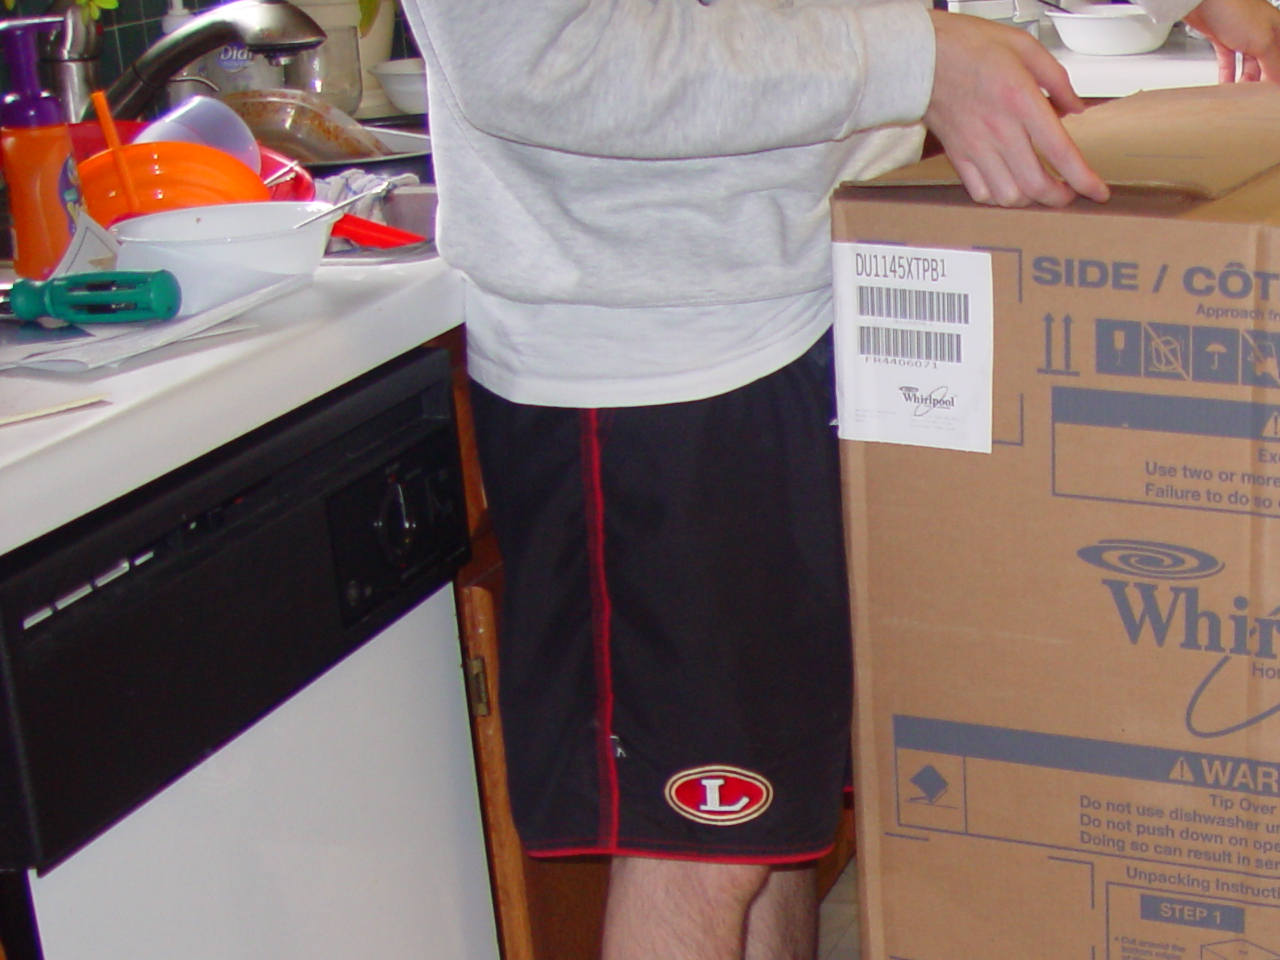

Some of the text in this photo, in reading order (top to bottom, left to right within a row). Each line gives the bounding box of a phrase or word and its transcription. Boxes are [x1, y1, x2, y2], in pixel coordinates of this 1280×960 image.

[855, 253, 947, 282] DU1145XTPB1
[1032, 256, 1139, 291] SIDE
[1152, 264, 1169, 294] /
[1196, 304, 1264, 321] Approach
[902, 392, 955, 408] Whirlpool
[1145, 461, 1177, 477] Use
[1182, 465, 1213, 481] two
[1218, 470, 1236, 482] or
[1145, 482, 1201, 501] Failure
[1206, 489, 1222, 503] to
[1228, 491, 1249, 506] do
[1254, 498, 1273, 510] so
[700, 779, 750, 811] L
[1209, 794, 1234, 810] Tip
[1239, 798, 1277, 814] Over
[1080, 795, 1101, 810] Do
[1106, 801, 1131, 814] not
[1136, 806, 1164, 818] use
[1169, 808, 1260, 832] dishwasher
[1080, 813, 1101, 828] Do
[1106, 819, 1131, 833] not
[1136, 822, 1175, 838] push
[1179, 827, 1223, 845] down
[1228, 835, 1248, 847] on
[1080, 831, 1125, 852] Doing
[1130, 840, 1149, 852] so
[1154, 844, 1182, 857] can
[1187, 847, 1232, 864] result
[1237, 852, 1250, 866] in
[1126, 866, 1211, 892] Unpacking
[1161, 902, 1221, 924] STEP 1
